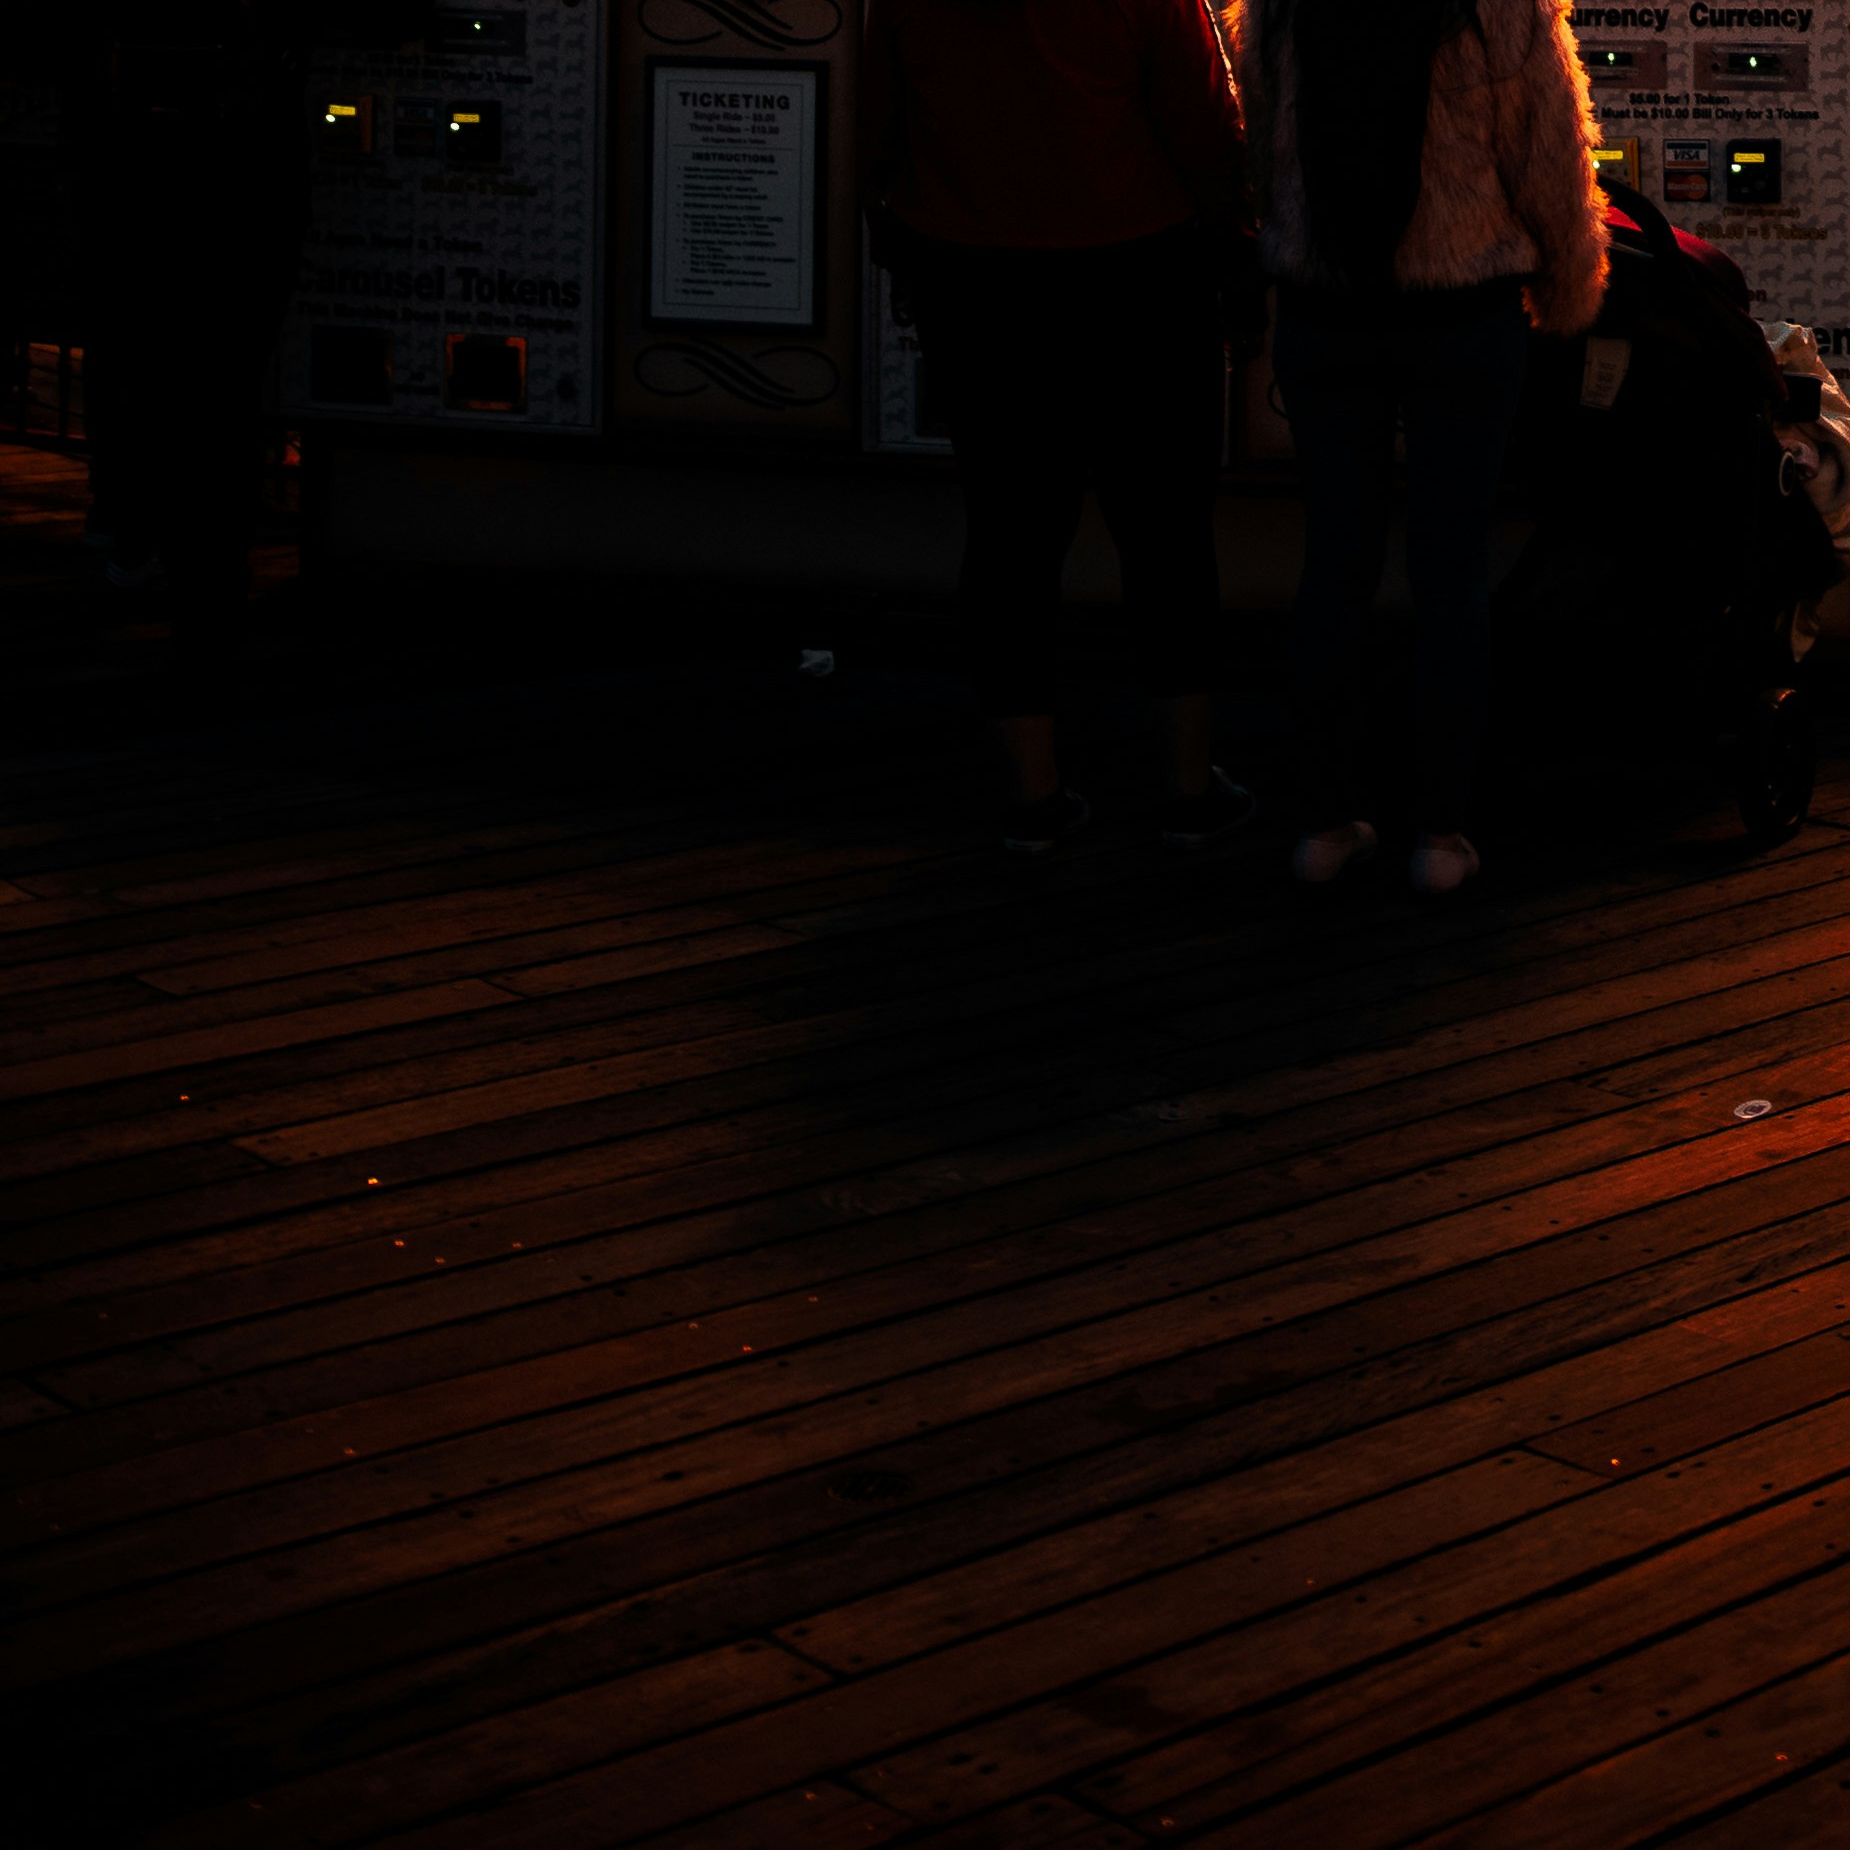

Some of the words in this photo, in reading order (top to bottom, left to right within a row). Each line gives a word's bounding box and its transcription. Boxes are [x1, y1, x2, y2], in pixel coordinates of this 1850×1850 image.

[1570, 6, 1670, 32] urrency
[1689, 2, 1813, 31] Currency
[678, 91, 791, 111] TICKETING
[1663, 92, 1680, 104] for
[1694, 92, 1730, 105] Token
[1601, 106, 1633, 119] Must
[1650, 107, 1689, 120] $10.00
[1692, 107, 1712, 119] Bill
[1715, 107, 1743, 121] Only
[1745, 107, 1762, 120] for
[1776, 108, 1820, 121] Tokens
[691, 152, 776, 165] INSTRUCTIONS
[1673, 149, 1701, 161] VISA
[456, 266, 581, 309] Tokens
